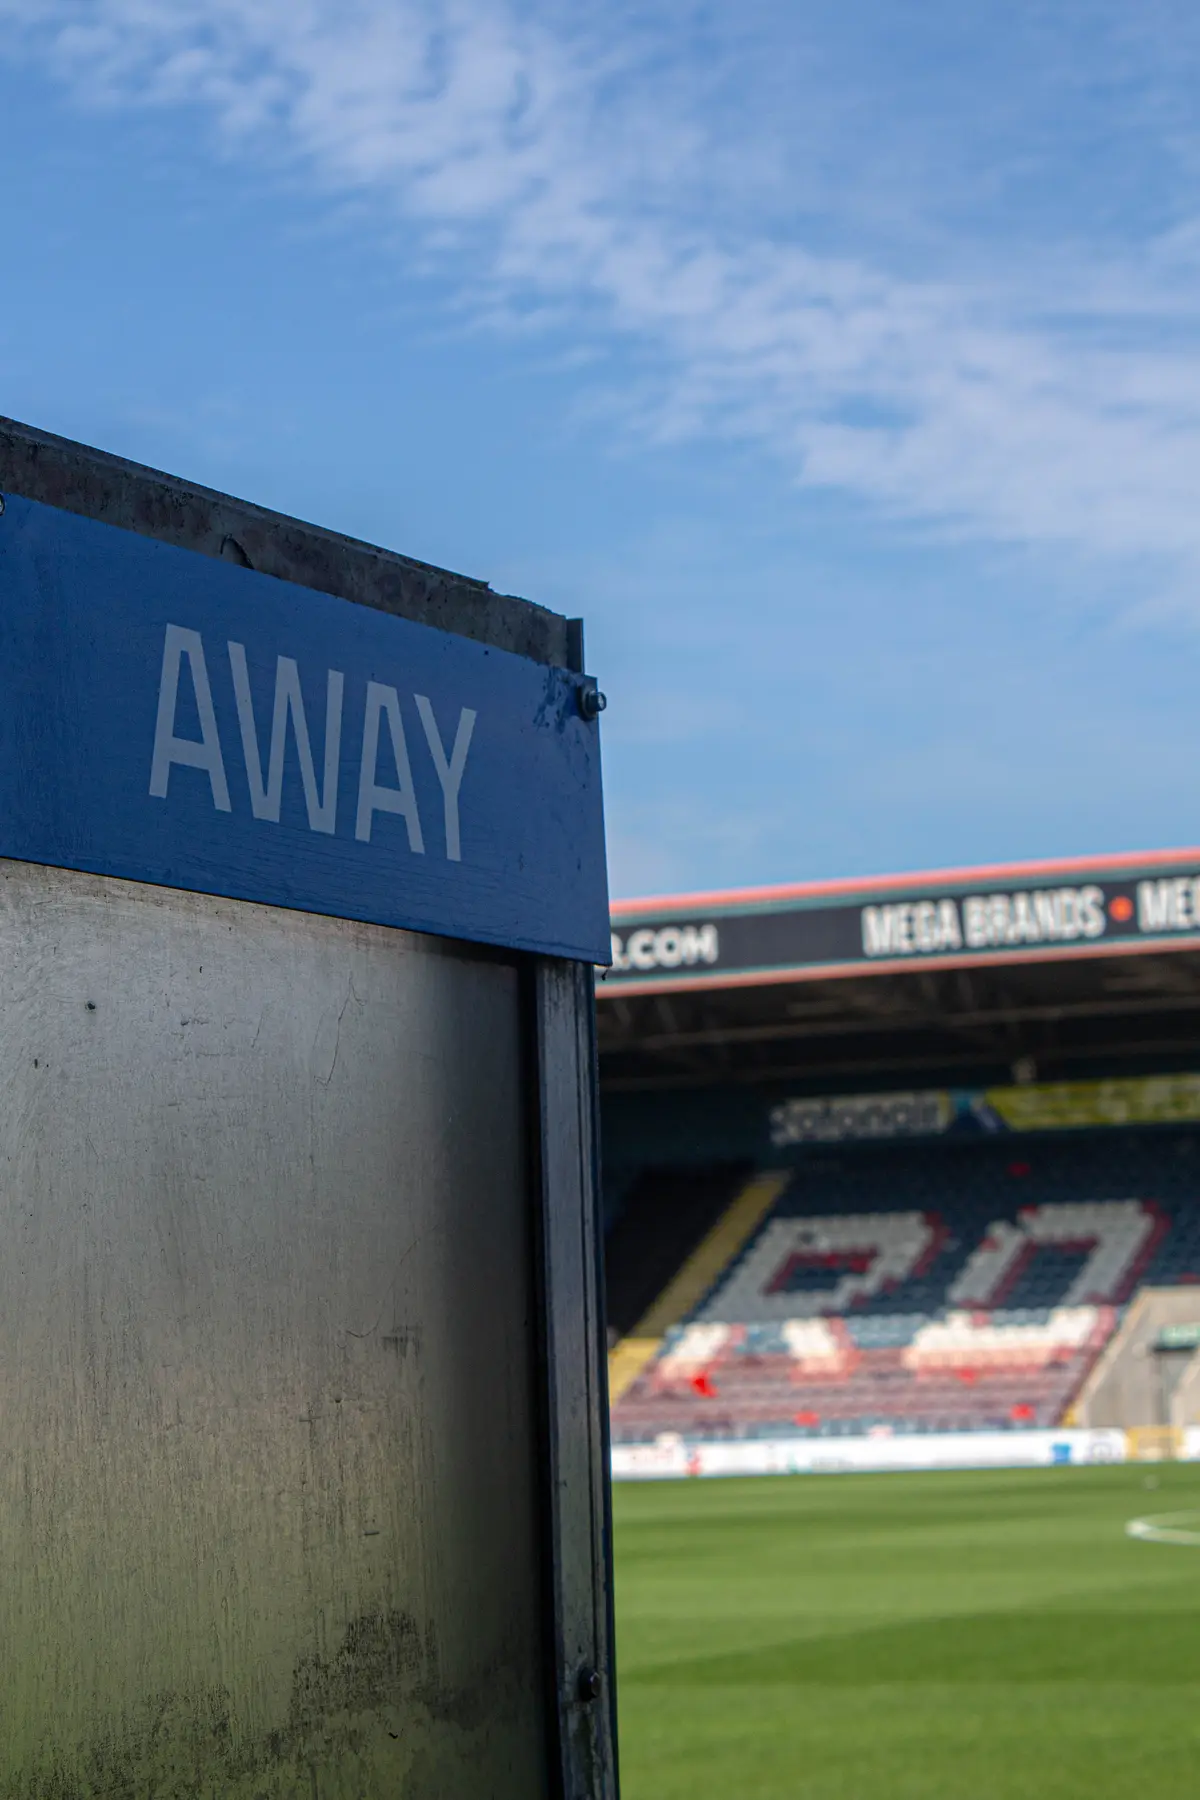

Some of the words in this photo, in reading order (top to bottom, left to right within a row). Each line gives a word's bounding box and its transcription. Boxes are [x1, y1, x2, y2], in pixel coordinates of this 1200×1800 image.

[149, 623, 477, 861] AWAY
[862, 899, 962, 956] MEGA
[963, 885, 1105, 949] BRANDS
